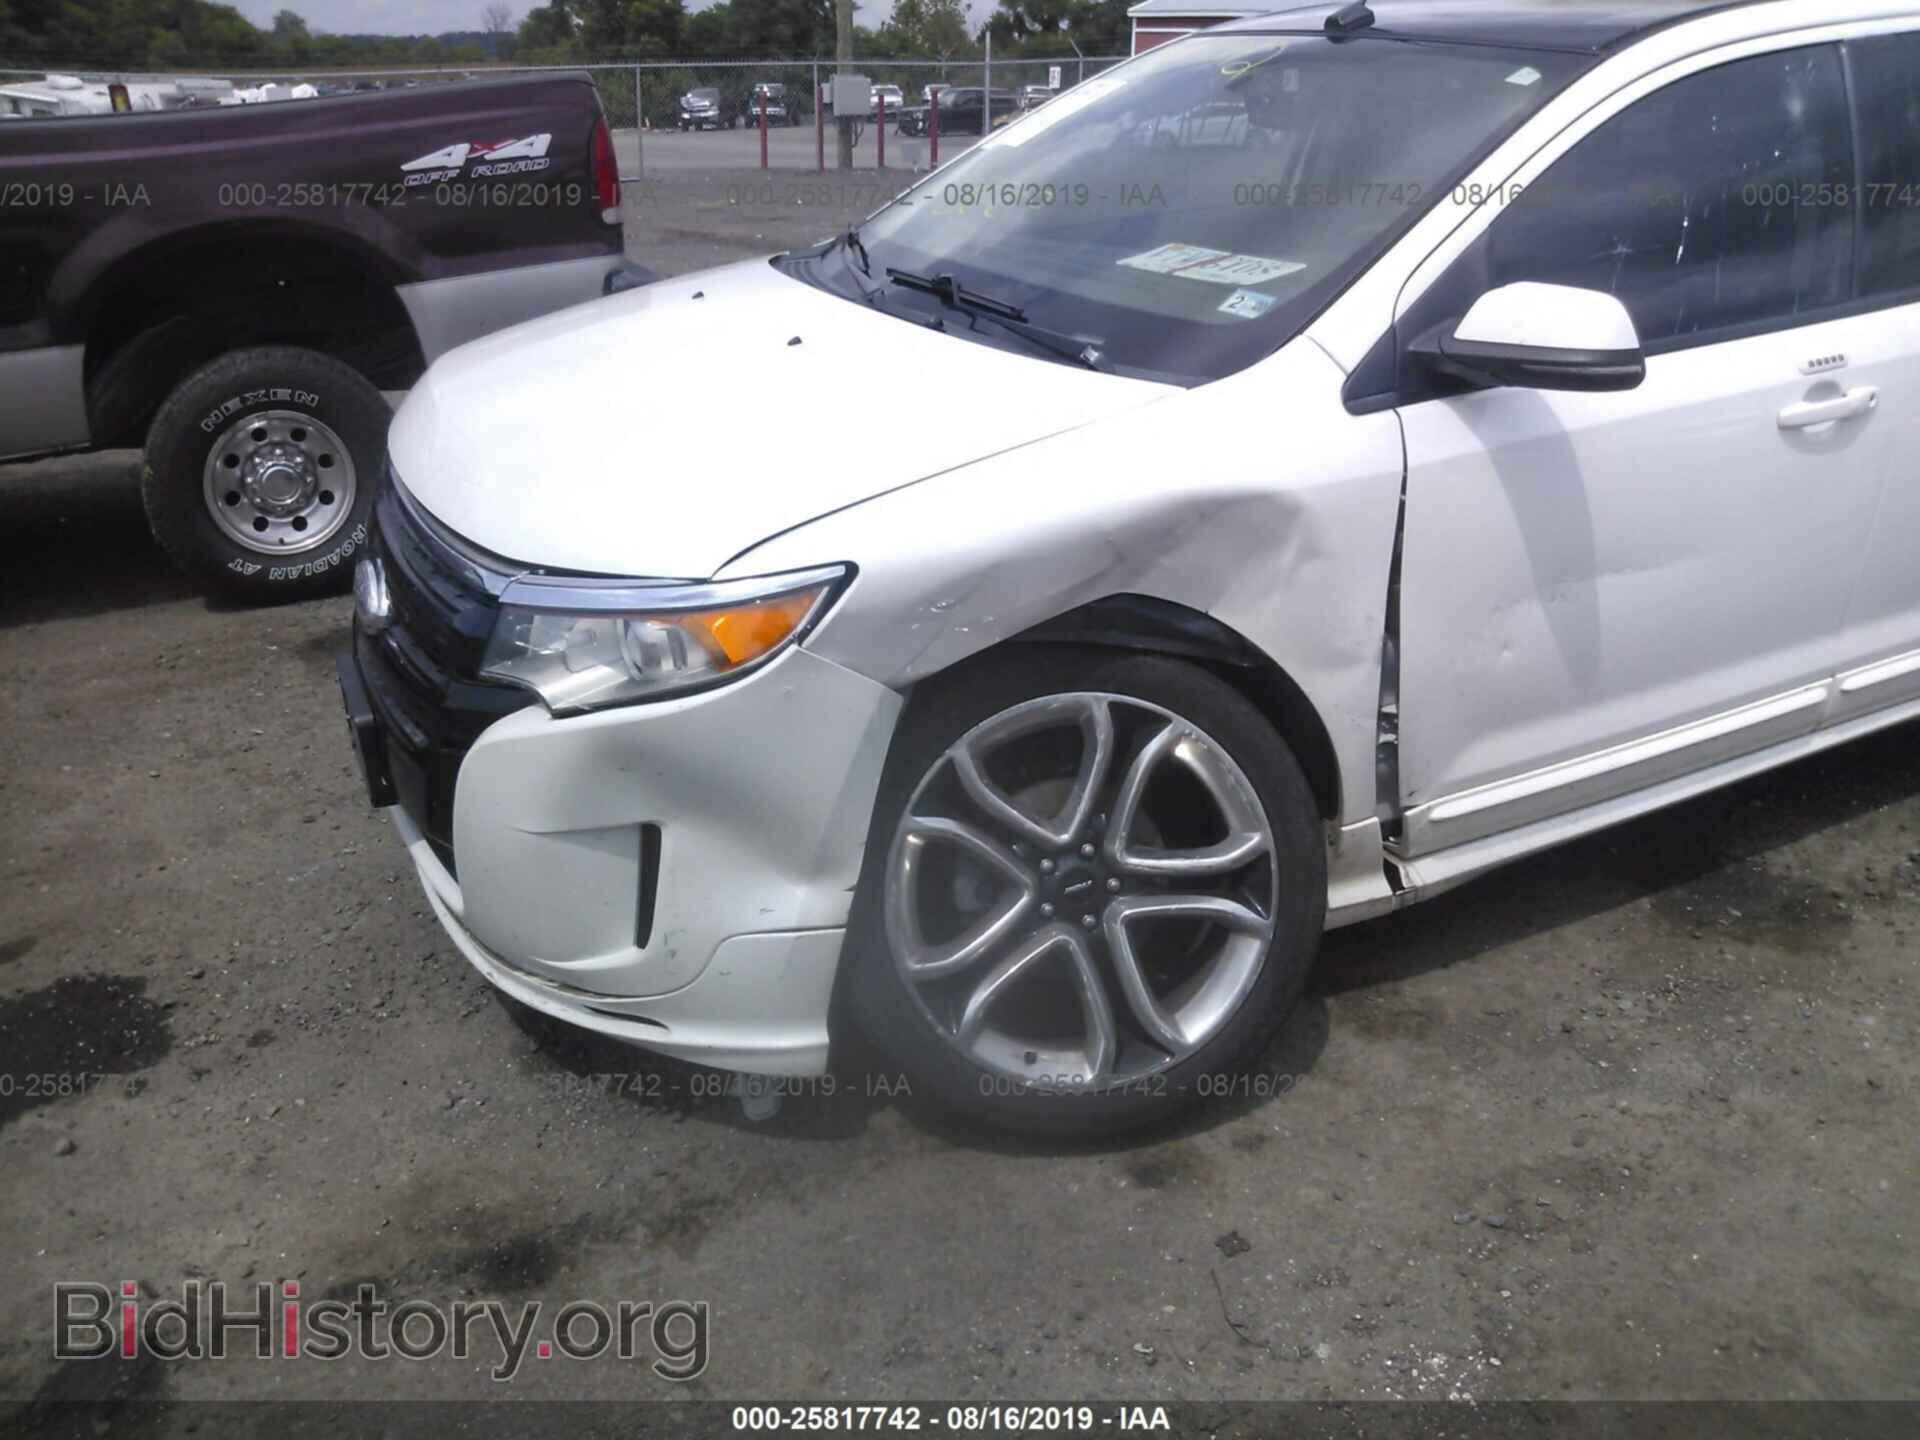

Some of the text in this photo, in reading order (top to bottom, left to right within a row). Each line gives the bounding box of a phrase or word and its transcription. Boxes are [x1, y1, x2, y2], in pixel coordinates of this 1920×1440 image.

[404, 157, 550, 187] OFF ROAD
[201, 388, 319, 432] NEXEN
[228, 522, 367, 580] ROADIAN AT
